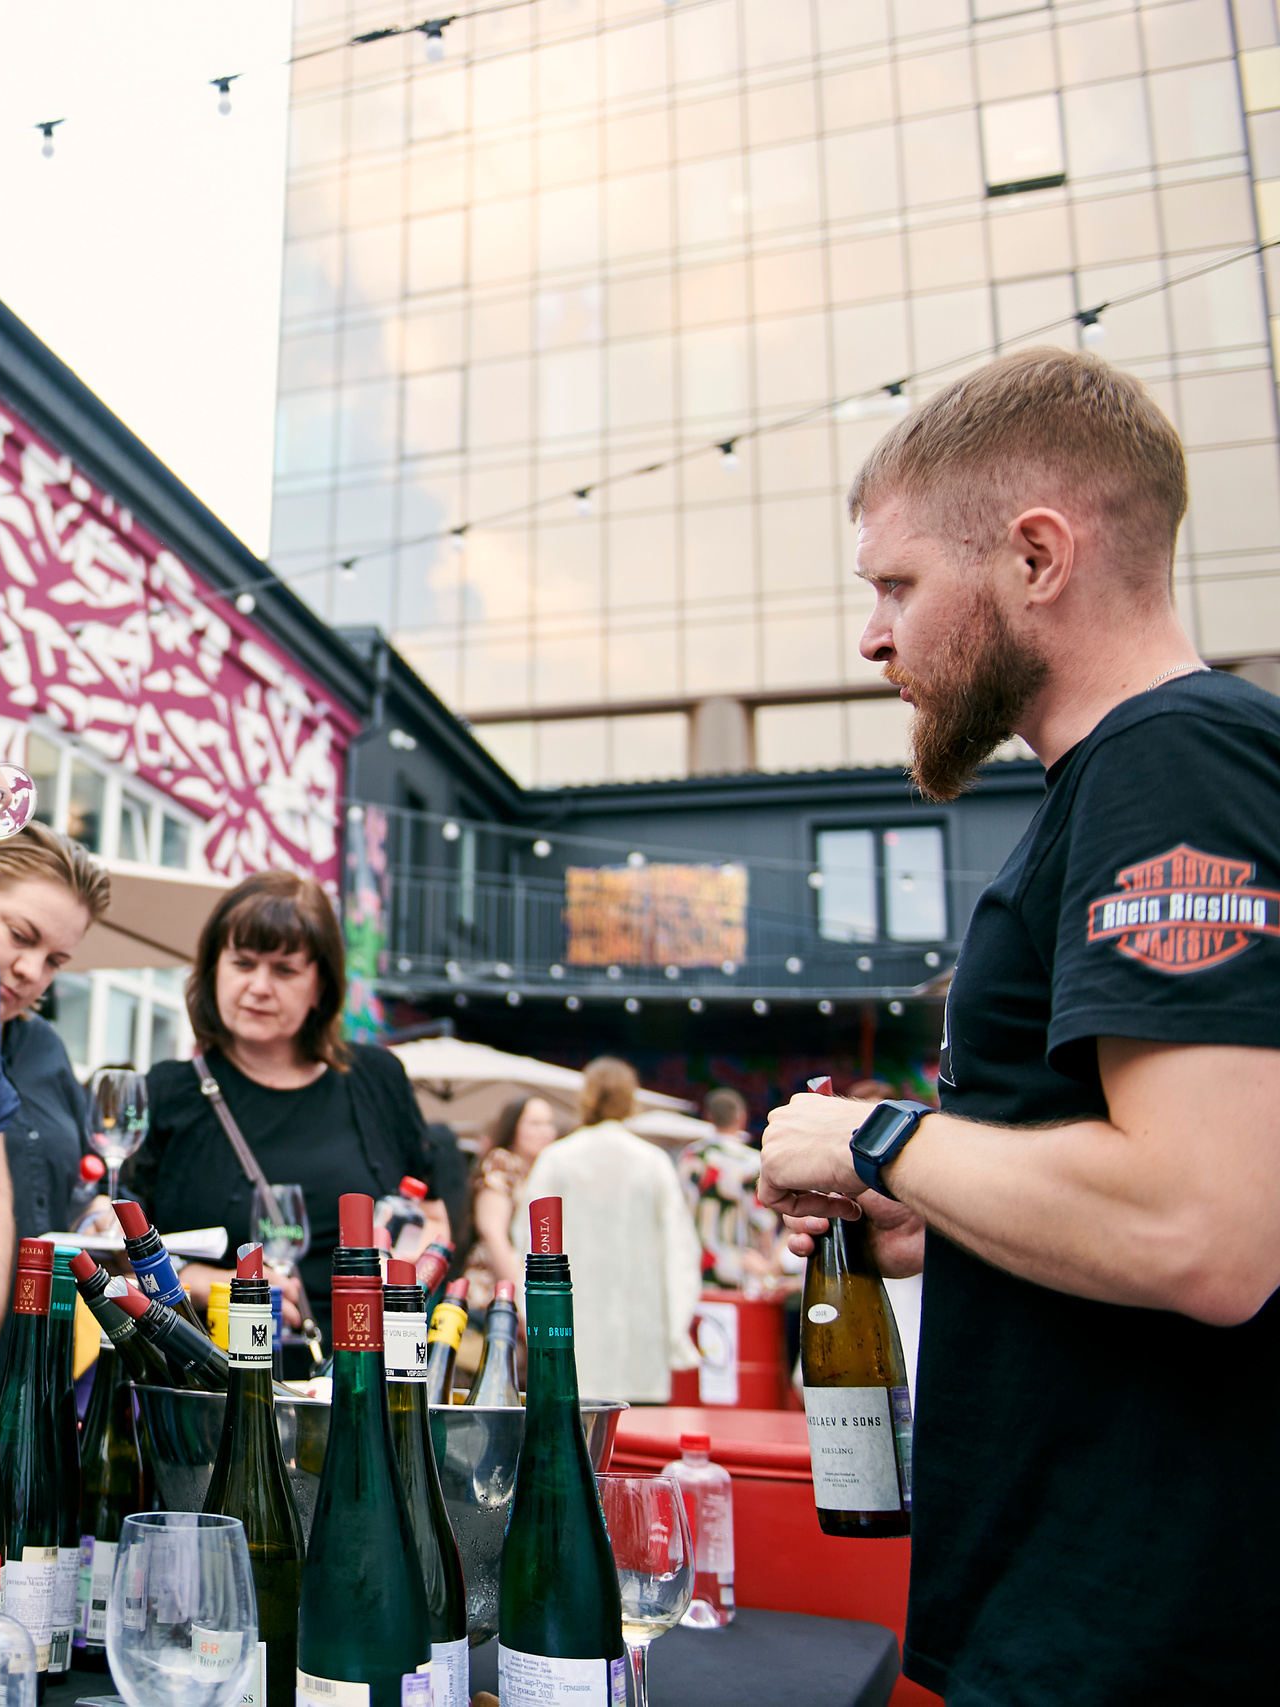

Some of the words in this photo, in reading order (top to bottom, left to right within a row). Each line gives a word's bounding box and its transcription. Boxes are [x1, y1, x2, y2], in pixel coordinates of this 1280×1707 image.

[1133, 863, 1164, 889] HIS
[1172, 854, 1232, 886] ROYAL
[1103, 896, 1160, 930] Rhein
[1170, 891, 1266, 929] Riesling
[1135, 928, 1225, 962] MAJESTY
[841, 1417, 848, 1426] &
[852, 1416, 881, 1427] SONS
[821, 1447, 854, 1455] RIESLING
